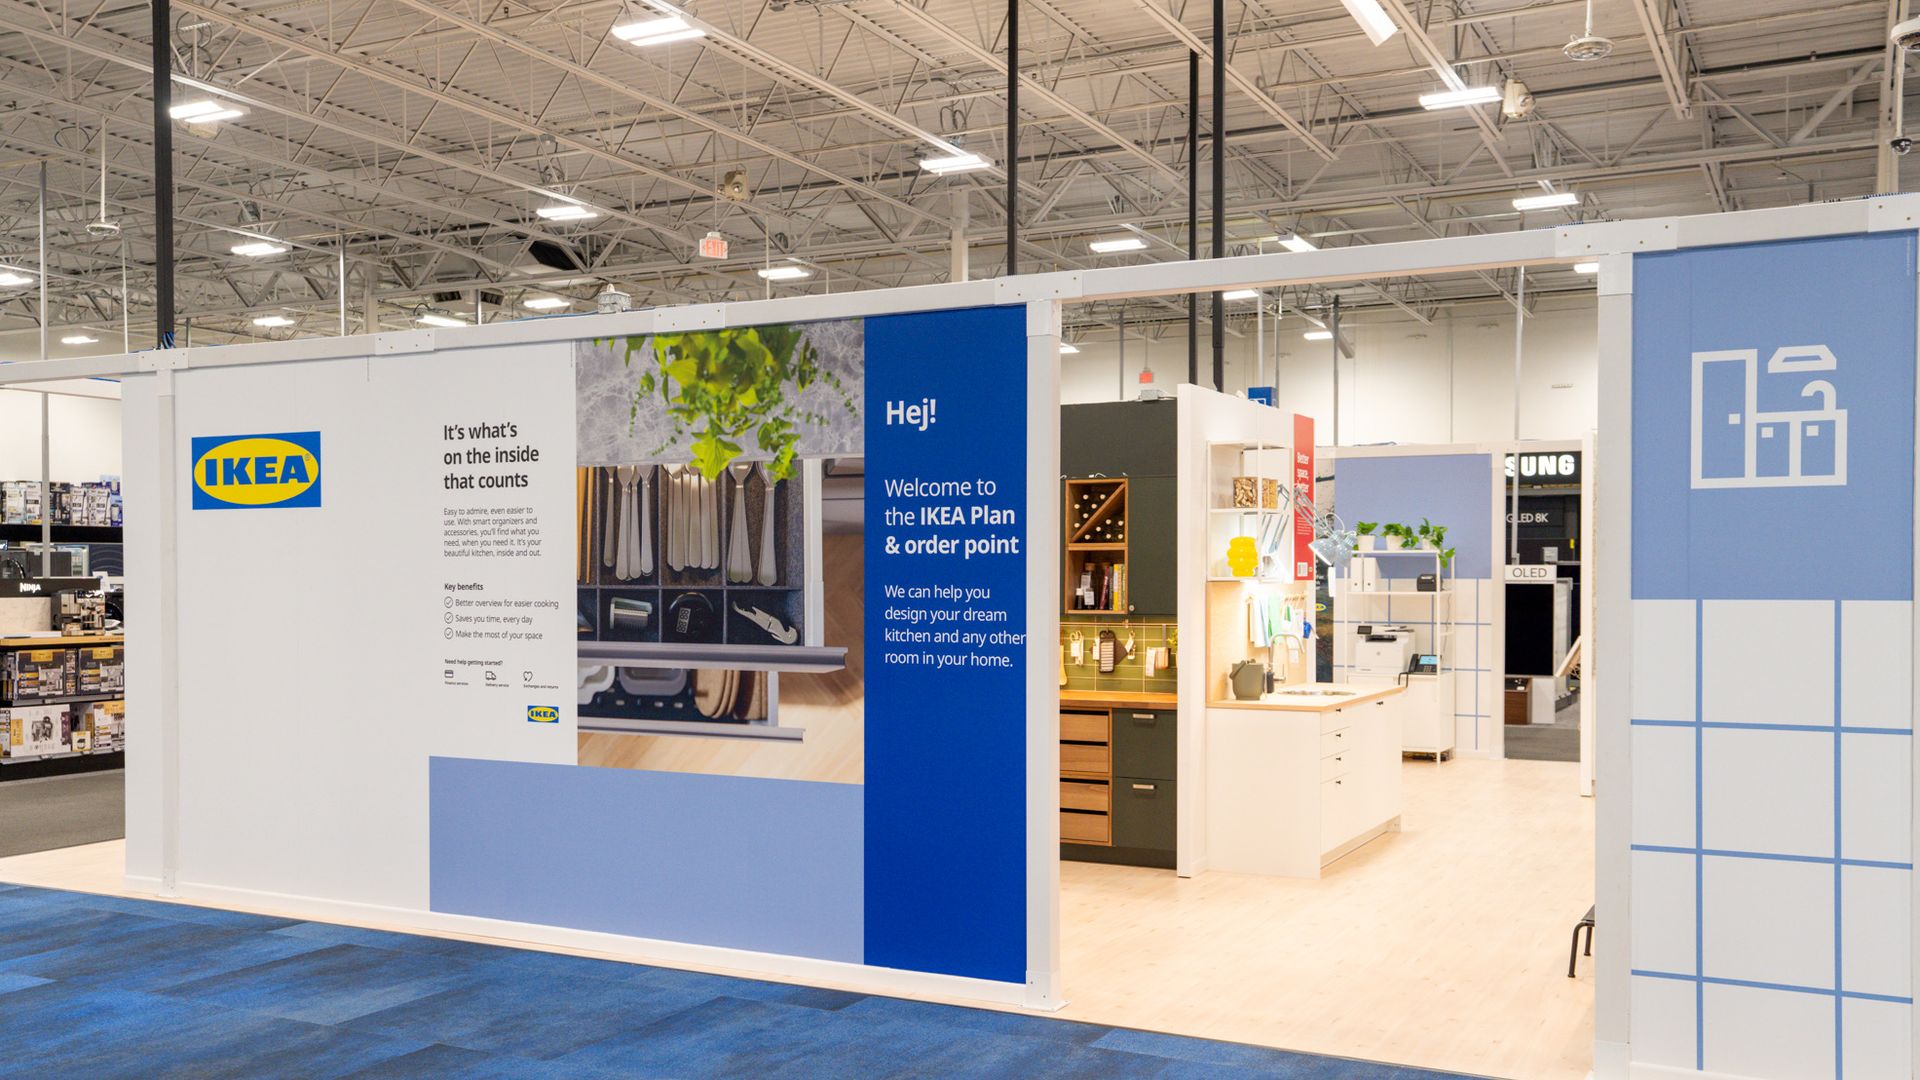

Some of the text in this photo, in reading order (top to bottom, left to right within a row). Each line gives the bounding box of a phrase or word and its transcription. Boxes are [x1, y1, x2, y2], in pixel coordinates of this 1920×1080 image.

[886, 398, 936, 431] Hej!
[444, 445, 539, 465] on the inside
[444, 473, 528, 489] that counts
[885, 478, 996, 497] Welcome to
[444, 508, 457, 517] Easy
[885, 505, 1015, 525] the IKEA Plan
[492, 517, 524, 527] organizers
[1535, 513, 1549, 523] 8K
[444, 538, 460, 547] need,
[480, 540, 491, 548] you
[527, 539, 541, 547] your
[885, 534, 1019, 559] & order point
[472, 549, 494, 557] kitchen,
[1513, 568, 1547, 578] OLED
[20, 583, 41, 593] NINJA
[445, 583, 455, 592] Key
[885, 585, 990, 602] We can help you
[534, 600, 559, 609] cooking
[474, 616, 485, 624] you
[486, 615, 501, 624] time,
[503, 617, 520, 625] every
[522, 615, 532, 625] day
[885, 606, 1007, 624] design your dream
[502, 631, 508, 639] of
[885, 628, 1026, 647] kitchen and any other
[885, 651, 1013, 669] room in your home.
